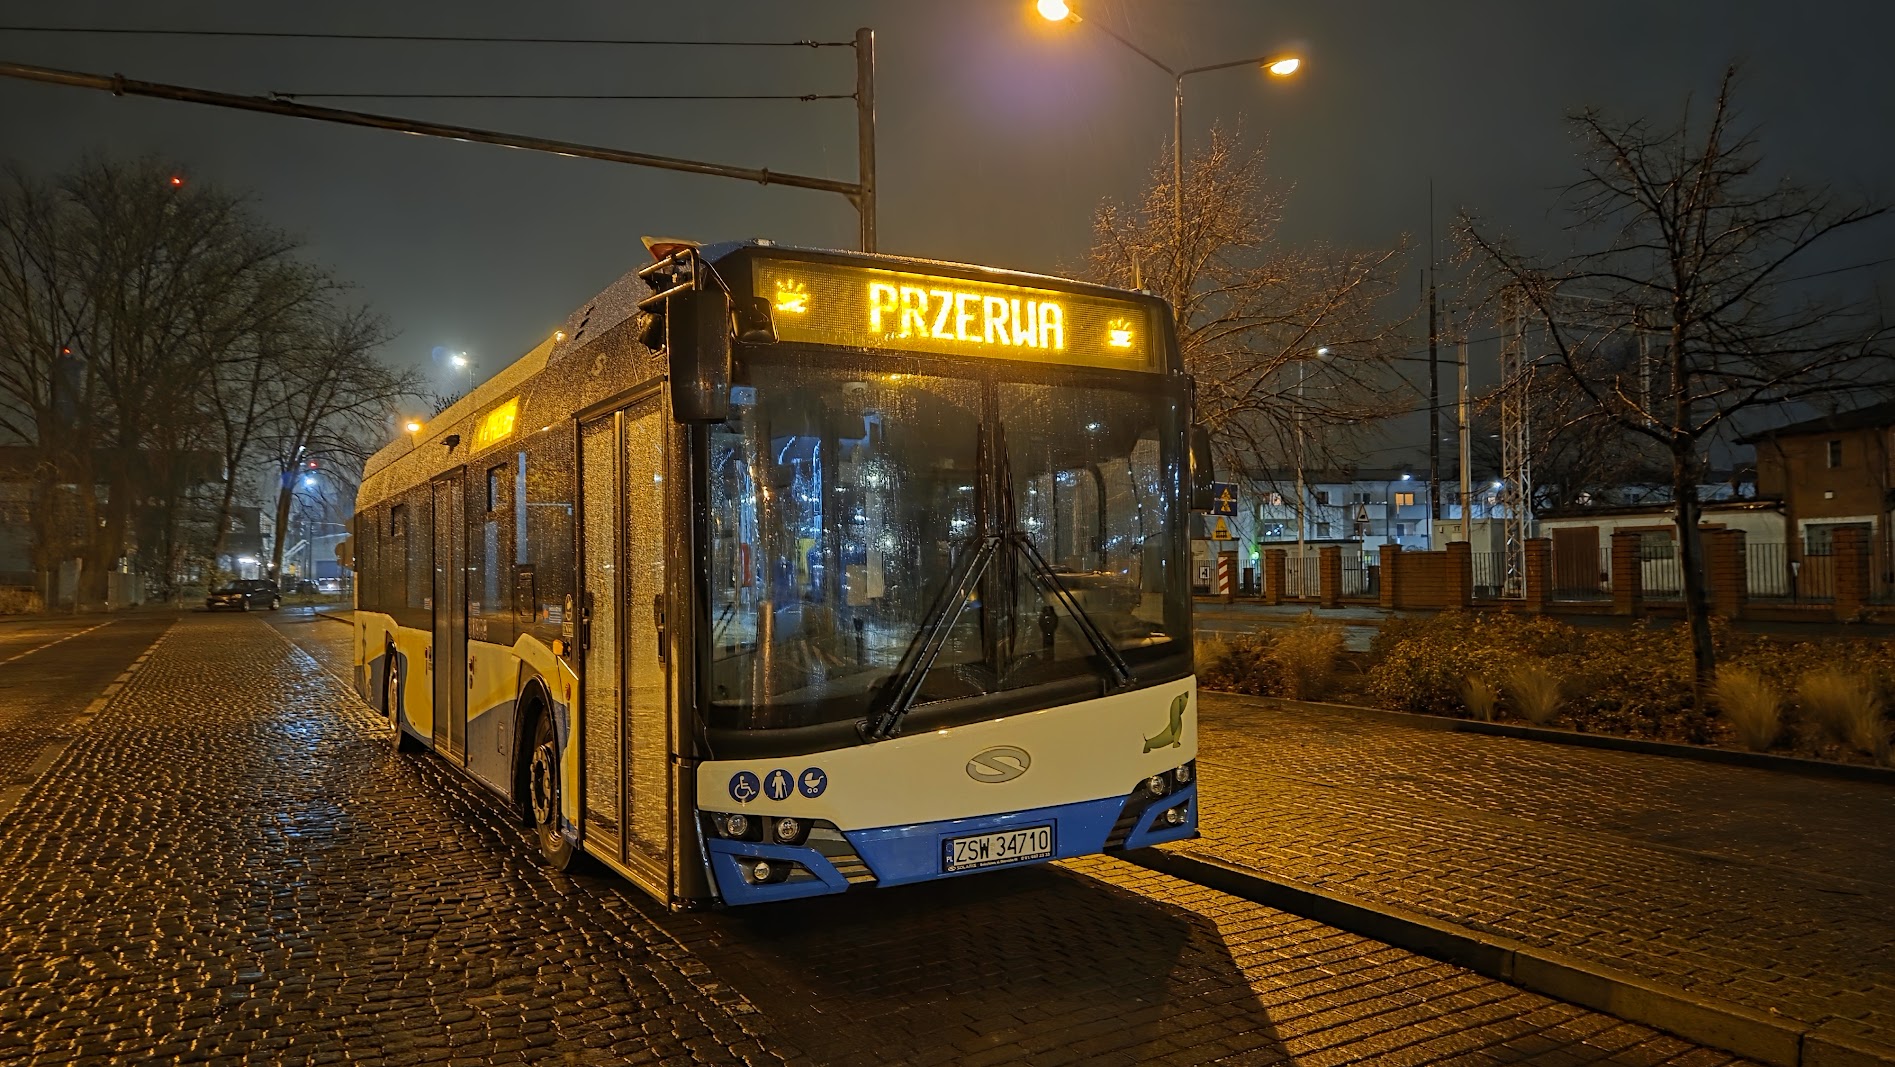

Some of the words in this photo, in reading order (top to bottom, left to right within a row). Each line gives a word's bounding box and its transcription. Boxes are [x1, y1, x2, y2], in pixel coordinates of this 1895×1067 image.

[869, 282, 1065, 350] PRZERWA
[955, 838, 990, 863] ZSW
[996, 830, 1048, 857] 34710
